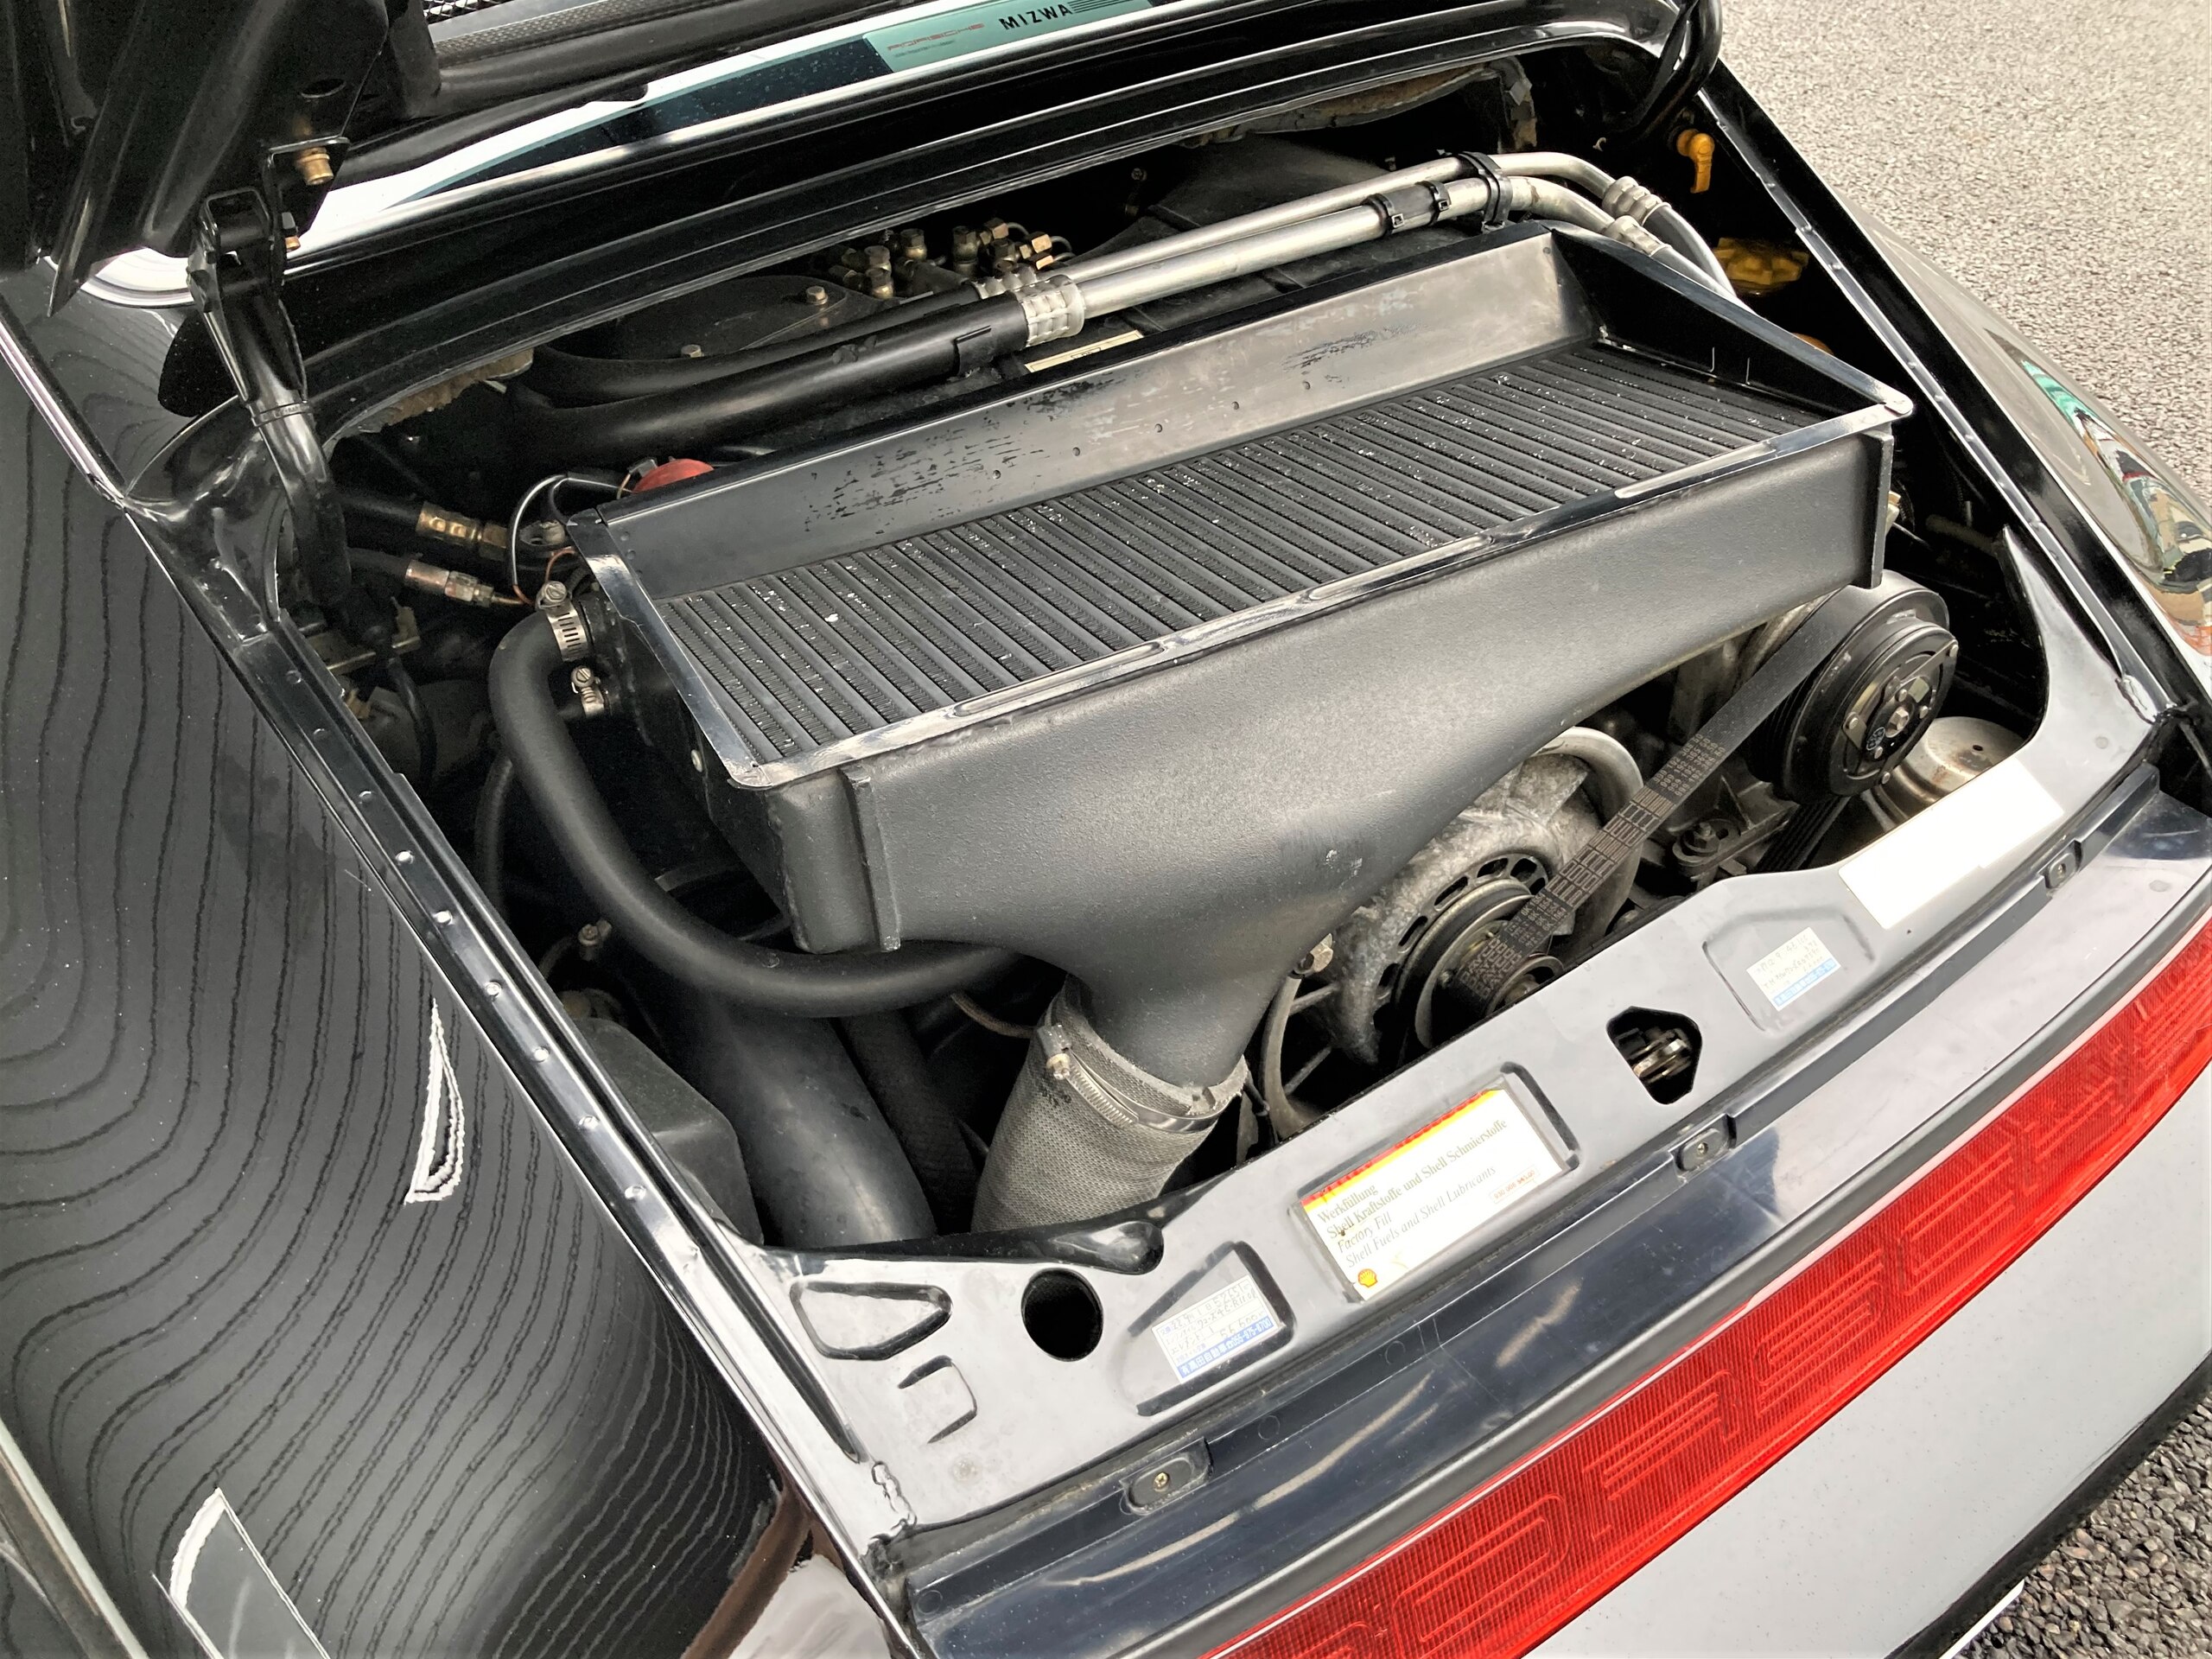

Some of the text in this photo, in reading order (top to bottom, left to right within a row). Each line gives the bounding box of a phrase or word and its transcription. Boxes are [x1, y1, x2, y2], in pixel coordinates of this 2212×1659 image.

[998, 3, 1073, 31] MIZWA
[1326, 1118, 1507, 1239] Shell Kraftstoffe und Shell Schmierstoffe
[1317, 1183, 1379, 1224] Werkfüllung
[1345, 1166, 1497, 1268] Shell Fuels and Shell Lubricants
[1337, 1211, 1393, 1254] Factory Fill
